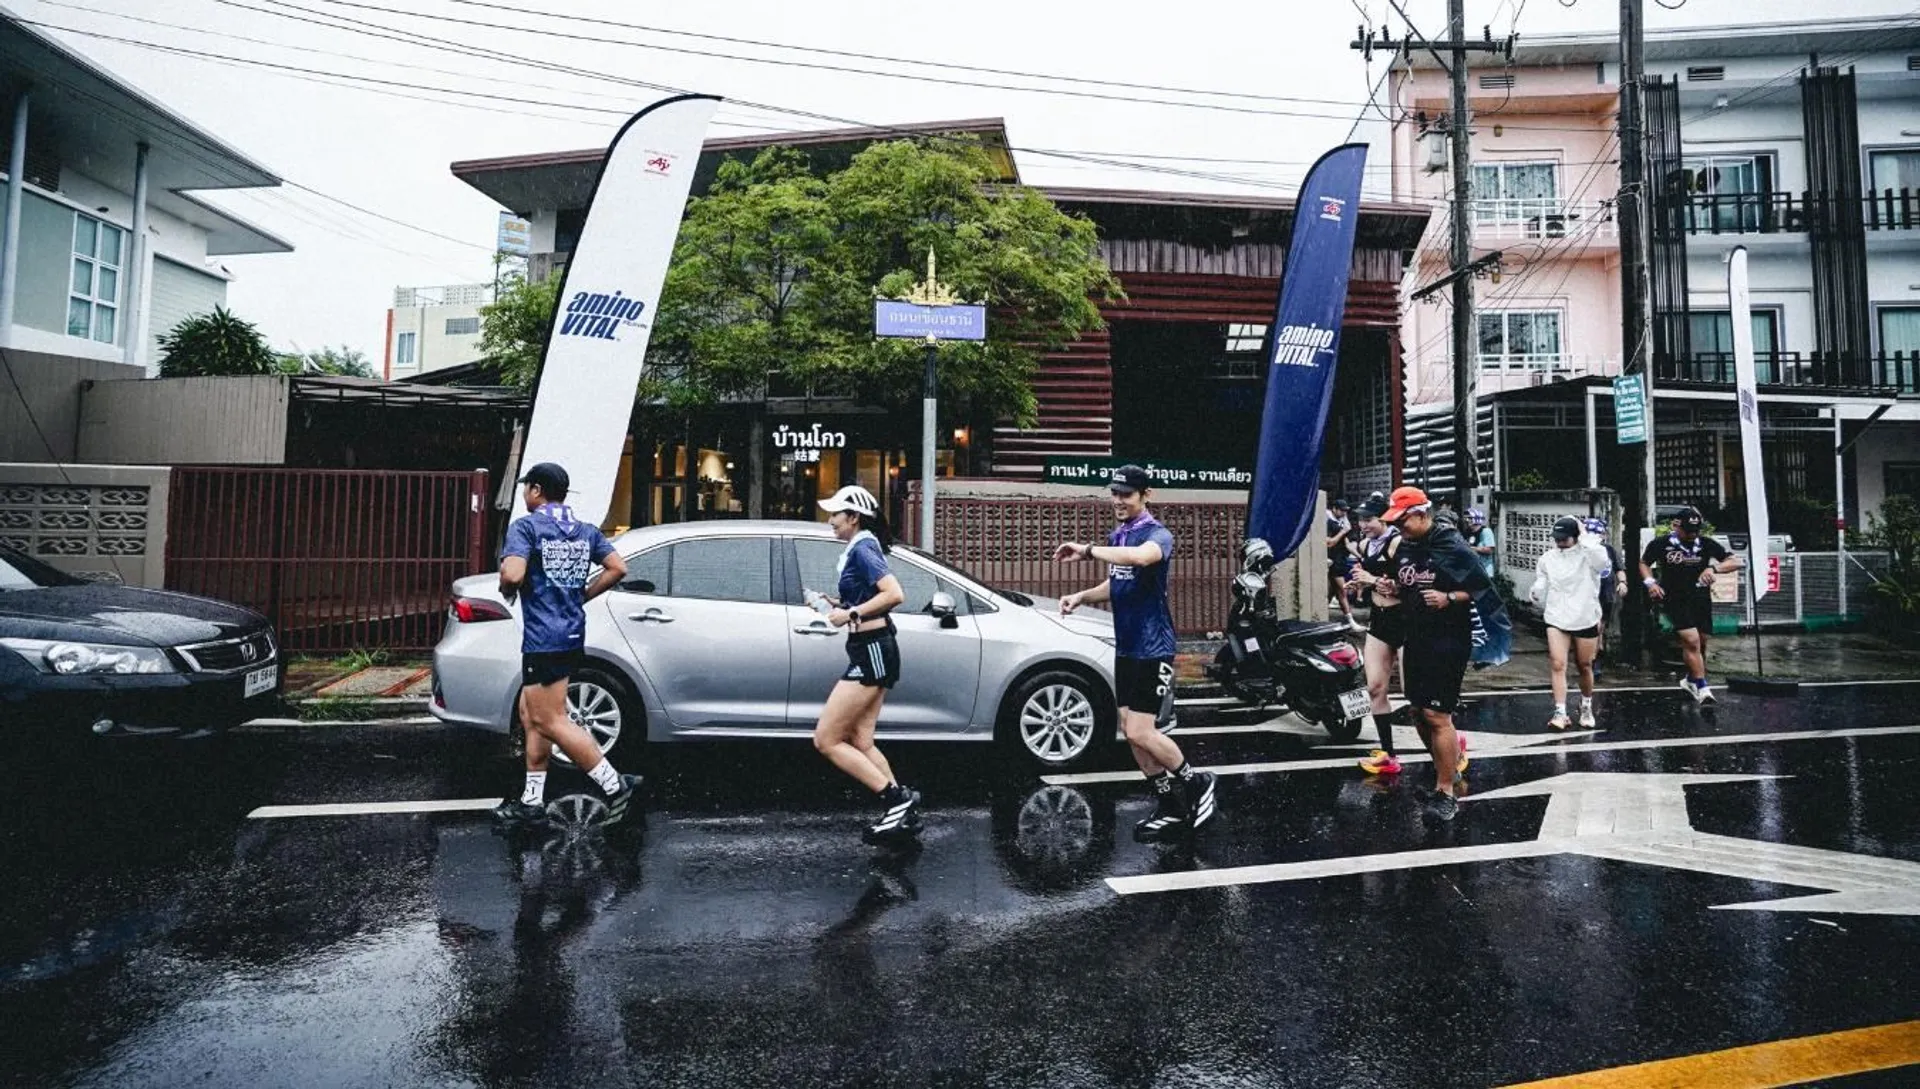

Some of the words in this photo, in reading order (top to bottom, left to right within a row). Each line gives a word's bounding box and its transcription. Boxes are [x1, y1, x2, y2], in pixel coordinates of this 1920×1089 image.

[566, 290, 645, 321] amino
[560, 313, 621, 340] VITAL
[1278, 323, 1334, 348] amino
[1274, 345, 1317, 367] VITAL
[772, 423, 846, 448] บ้านโกว
[1050, 463, 1089, 478] กาแฟ
[1198, 467, 1252, 483] จานเดียว
